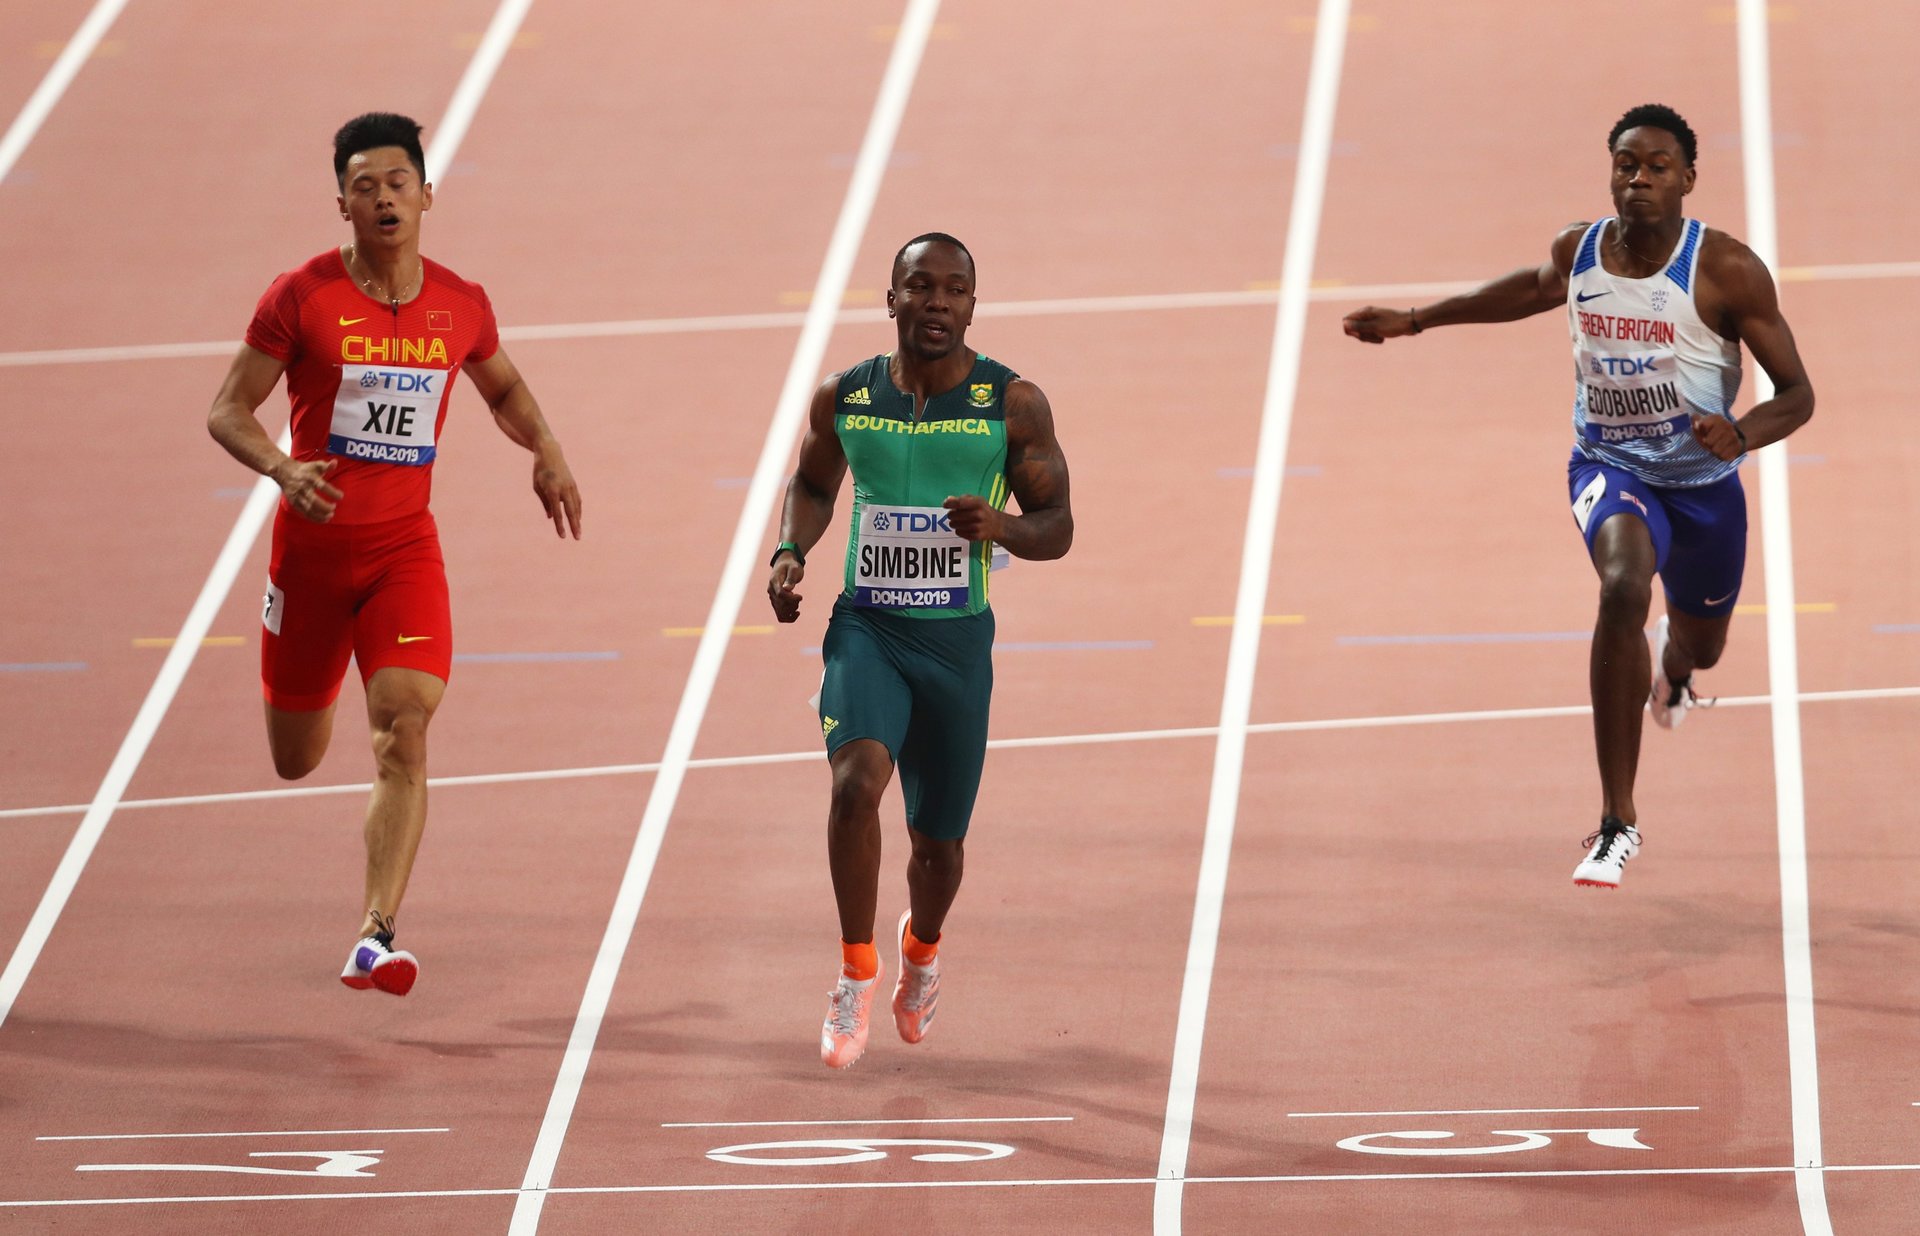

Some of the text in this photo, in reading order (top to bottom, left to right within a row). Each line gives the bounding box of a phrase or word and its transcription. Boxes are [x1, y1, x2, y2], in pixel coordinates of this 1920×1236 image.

[1578, 311, 1675, 343] GREAT BRITAIN
[342, 336, 447, 363] CHINA
[1601, 356, 1658, 376] TDK
[379, 371, 434, 393] TDK
[843, 396, 871, 406] adidas
[1587, 382, 1679, 417] EDOBURUN
[362, 401, 416, 437] XIE
[1601, 421, 1674, 441] DOHA2019
[346, 440, 419, 462] DOHA2019
[890, 513, 951, 532] TDK
[860, 544, 962, 579] SIMBINE
[871, 590, 950, 606] DOHA2019
[706, 1138, 1015, 1166] 6
[1336, 1127, 1655, 1156] 5
